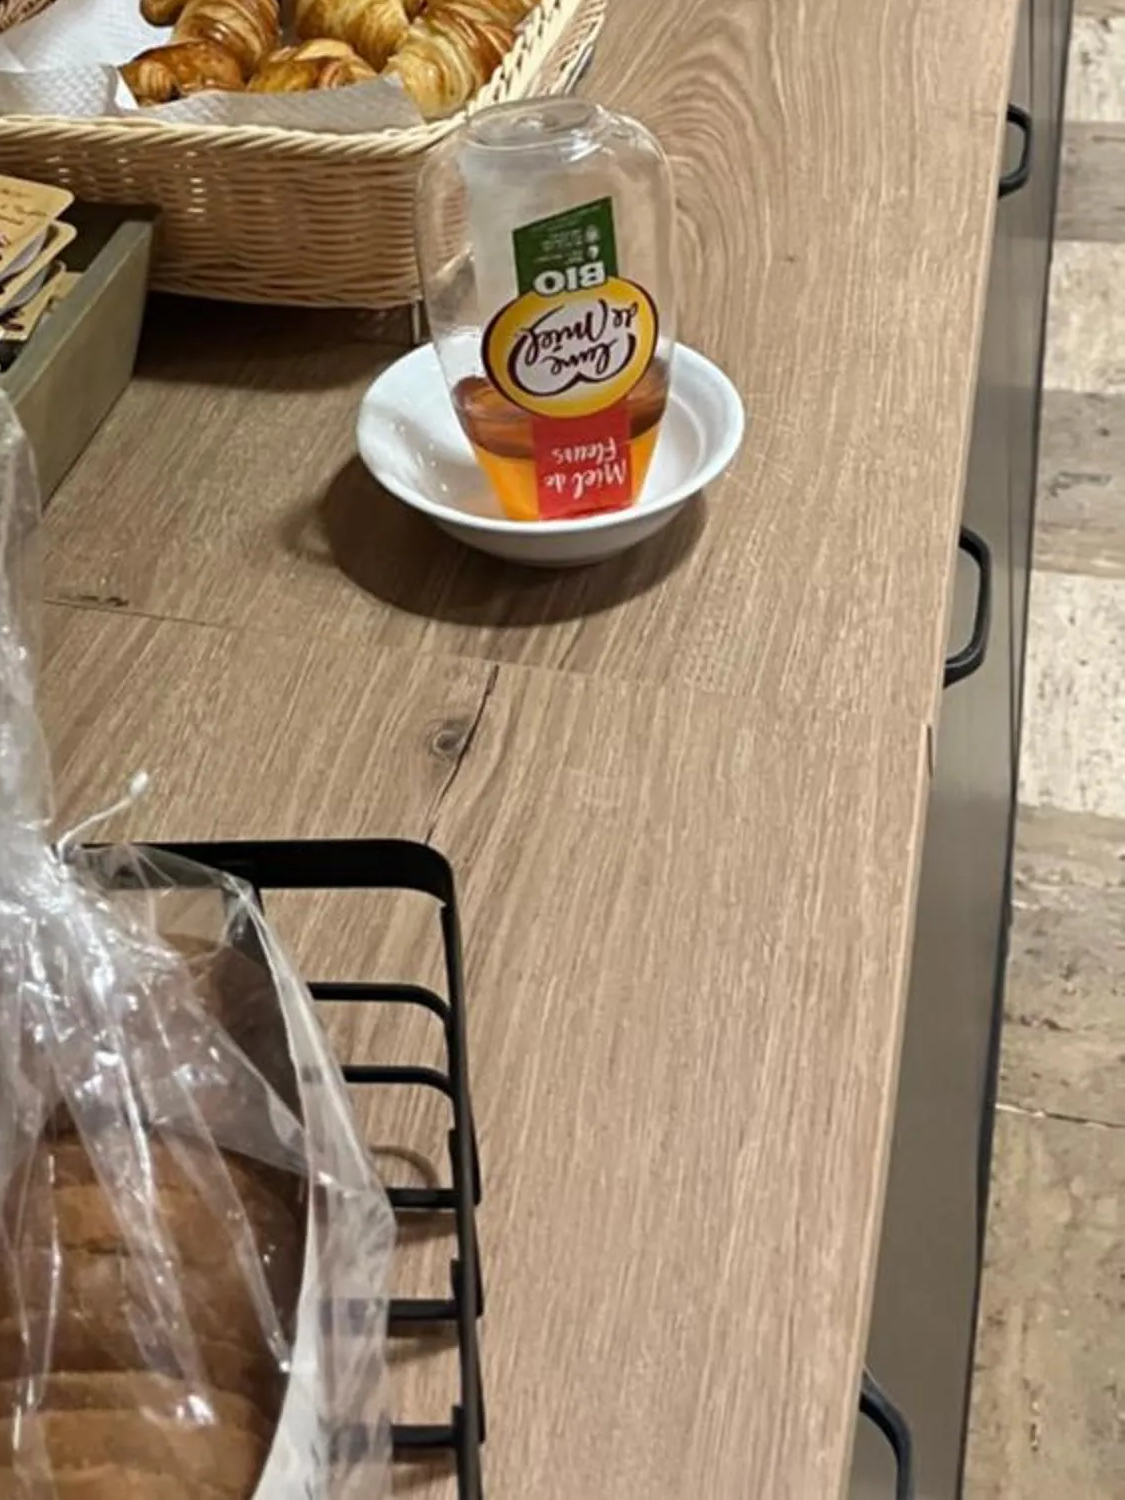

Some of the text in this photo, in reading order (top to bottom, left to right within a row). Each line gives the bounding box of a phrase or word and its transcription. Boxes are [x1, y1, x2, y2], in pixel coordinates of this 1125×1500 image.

[533, 261, 605, 296] BIO
[610, 301, 639, 330] de
[551, 436, 618, 466] Fleurs
[544, 458, 627, 501] Miel de
